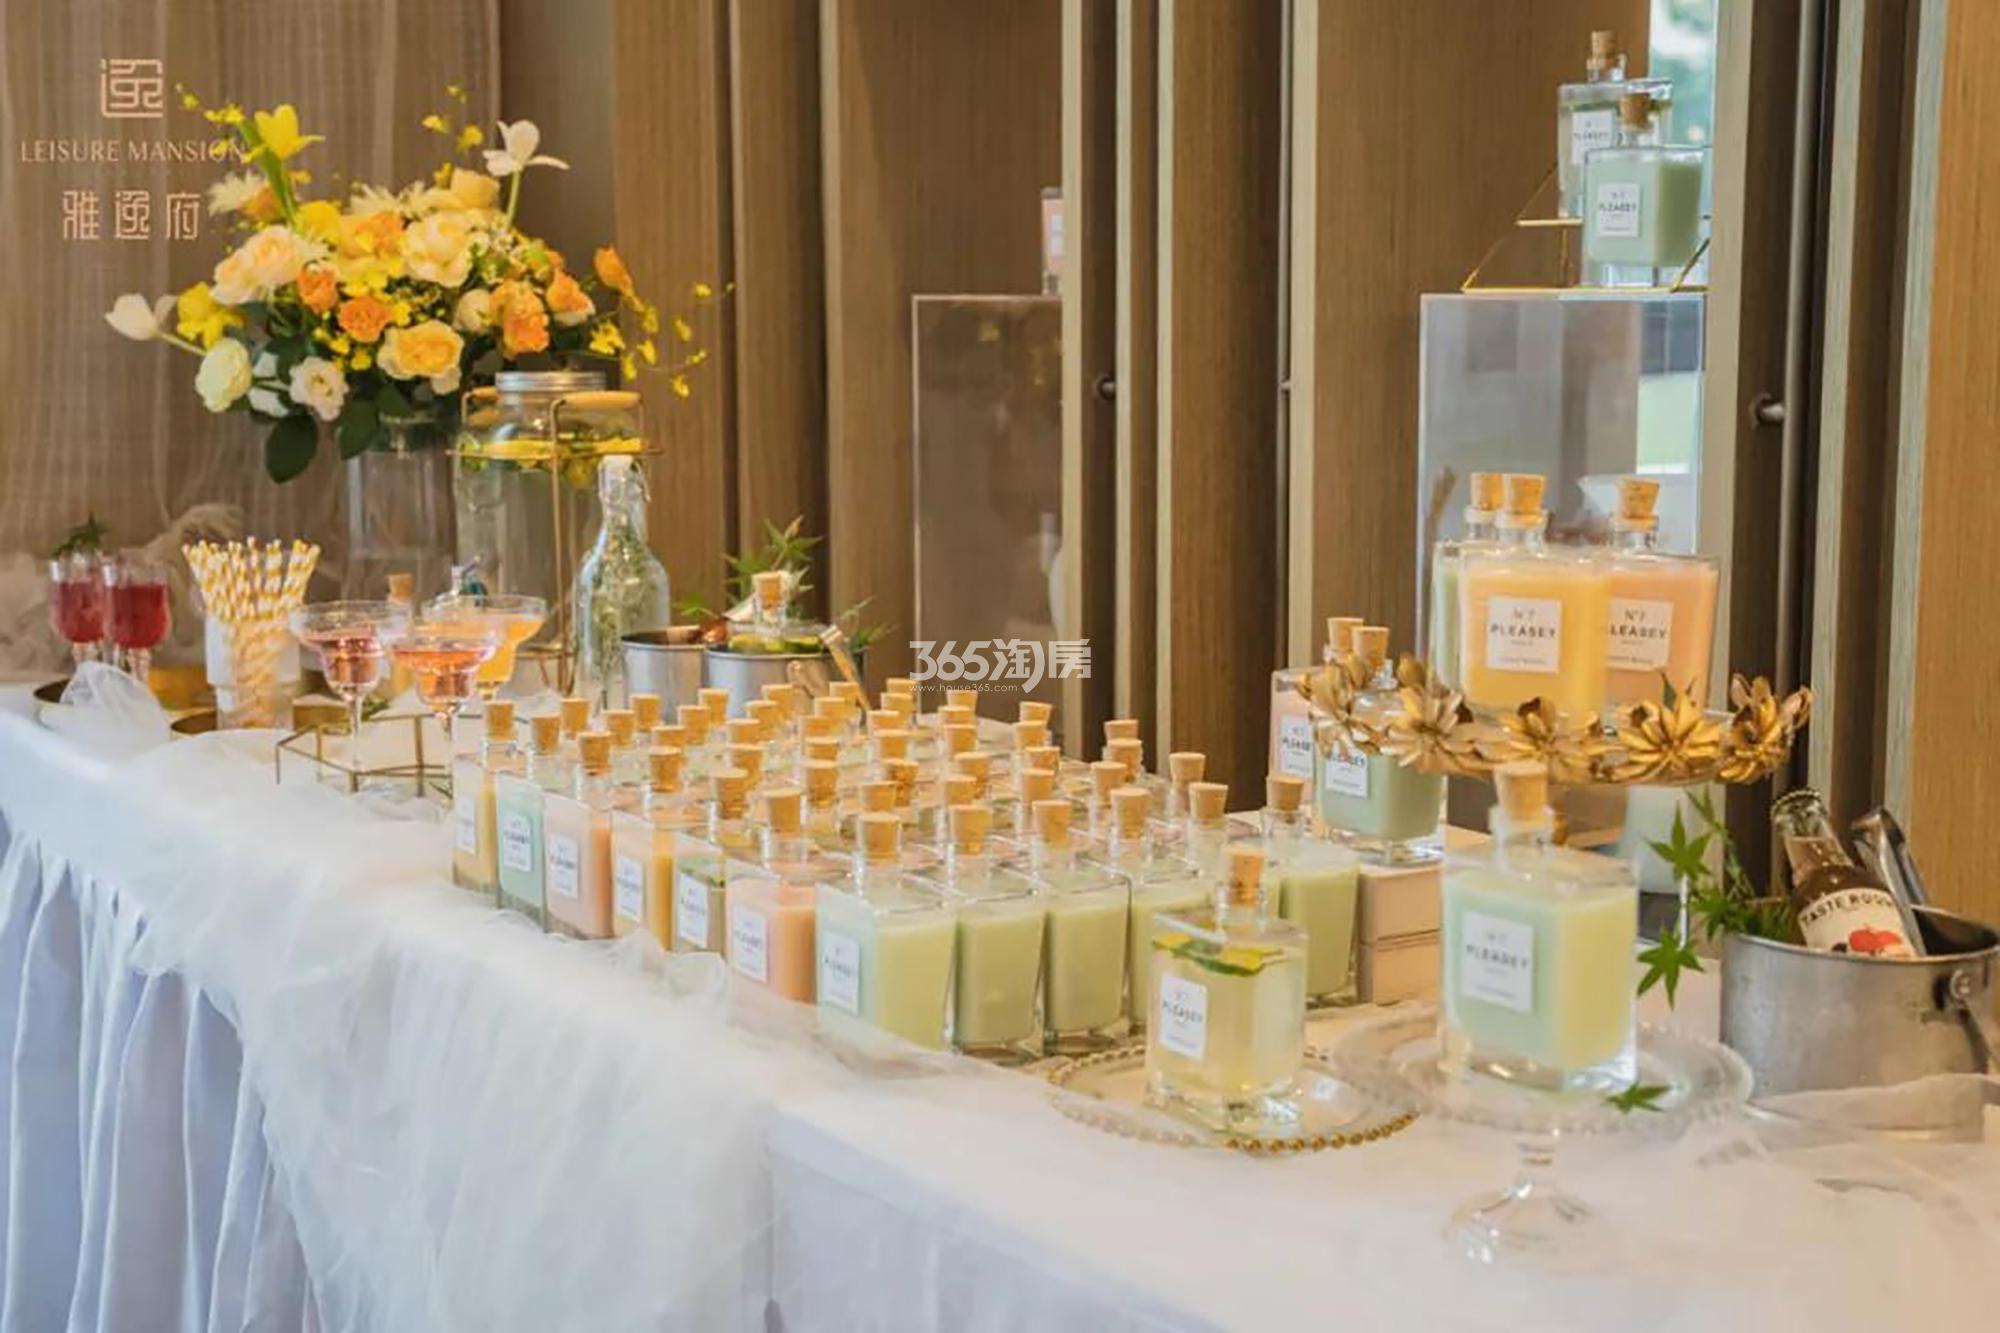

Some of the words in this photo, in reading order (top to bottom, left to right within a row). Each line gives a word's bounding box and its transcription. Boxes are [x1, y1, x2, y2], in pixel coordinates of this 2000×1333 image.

[1490, 623, 1556, 639] PLEASEY
[1609, 624, 1667, 639] LEASEY
[1801, 896, 1844, 926] TASTE
